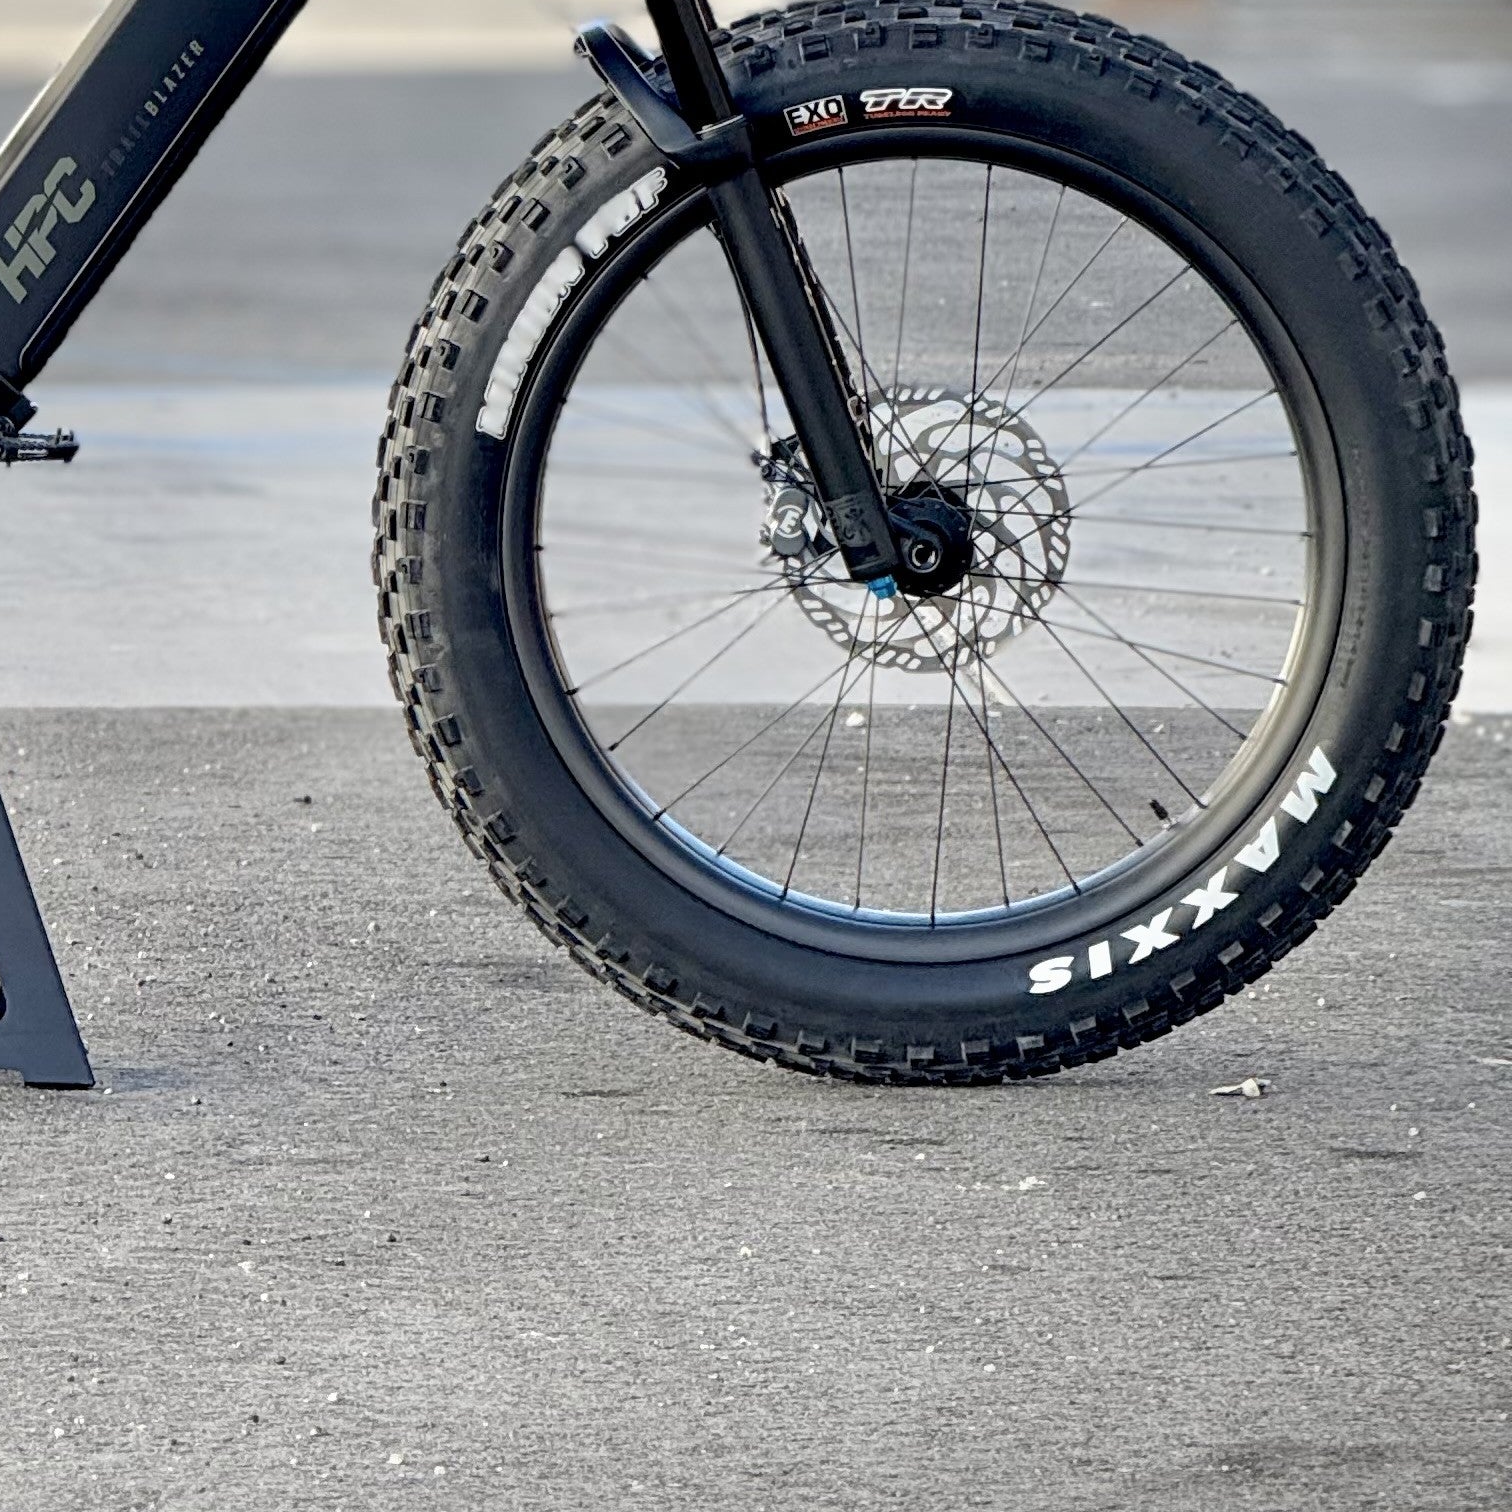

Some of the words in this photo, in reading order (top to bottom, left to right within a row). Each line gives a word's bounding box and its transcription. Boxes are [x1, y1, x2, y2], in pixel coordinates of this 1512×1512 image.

[787, 97, 843, 127] EXO
[859, 88, 953, 111] TR
[1029, 746, 1336, 994] MAXXIS
